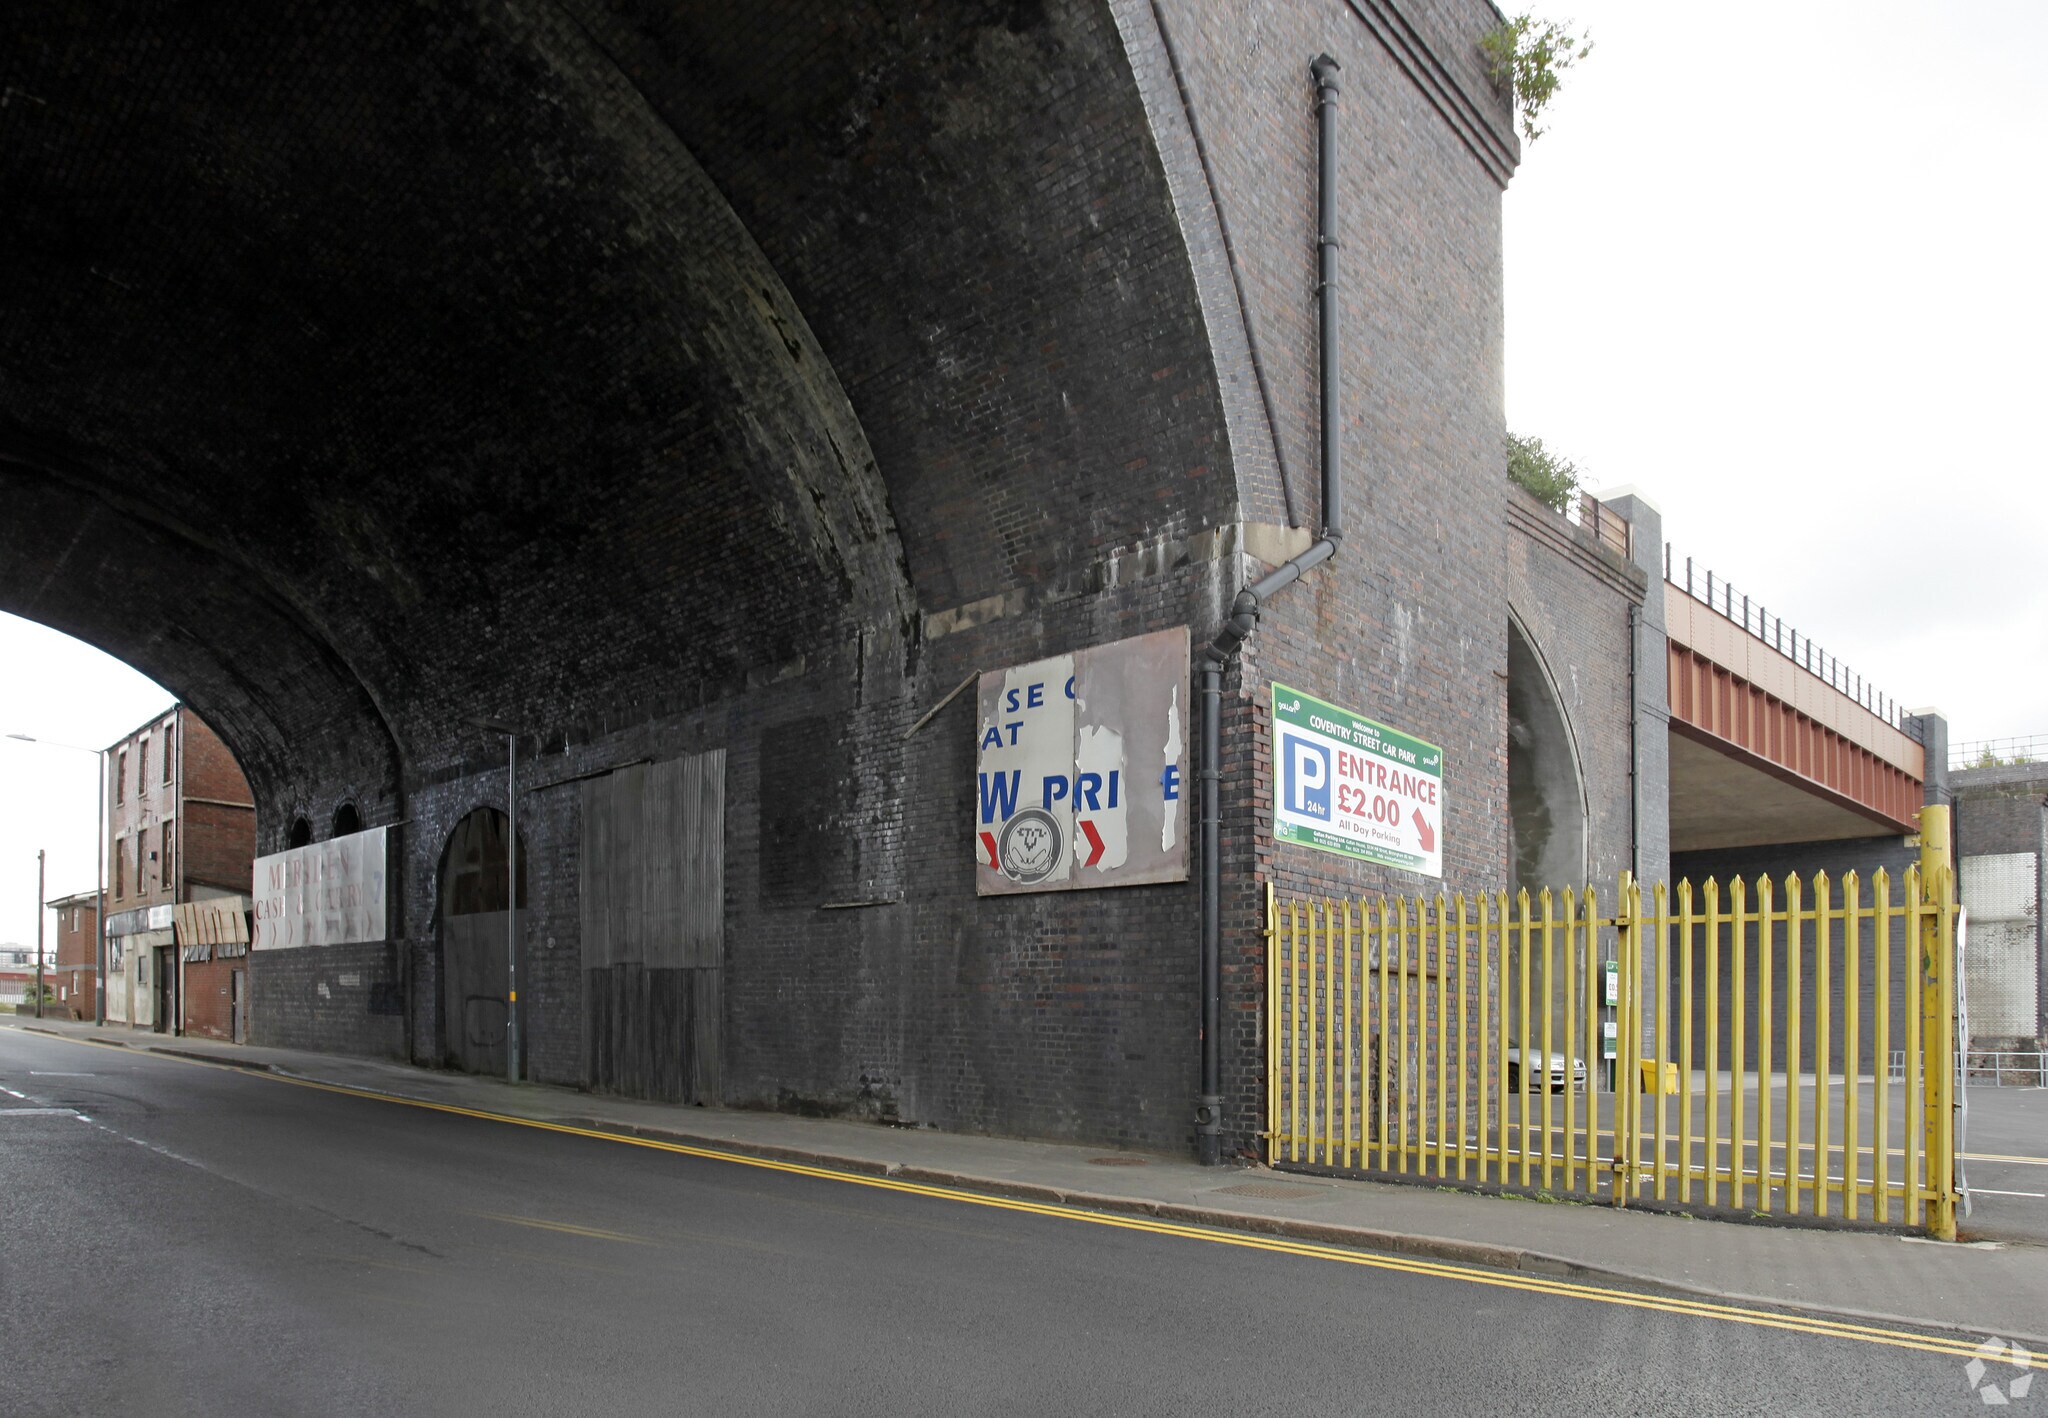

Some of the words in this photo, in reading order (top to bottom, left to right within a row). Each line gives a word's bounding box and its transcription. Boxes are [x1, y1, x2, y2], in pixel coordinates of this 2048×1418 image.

[1310, 715, 1351, 740] COVENTRY
[1353, 731, 1381, 751] STREET
[1382, 743, 1397, 757] CAR
[1398, 748, 1416, 764] PARK
[1352, 720, 1374, 735] Welcome
[1374, 728, 1380, 738] to
[979, 769, 1021, 824] W
[1295, 742, 1326, 810] P
[1338, 750, 1436, 805] ENTRANCE
[1338, 783, 1400, 827] £2.00
[1339, 819, 1351, 831] All
[1353, 823, 1370, 838] Day
[1372, 827, 1400, 846] Parking
[268, 843, 350, 891] MERIDEN
